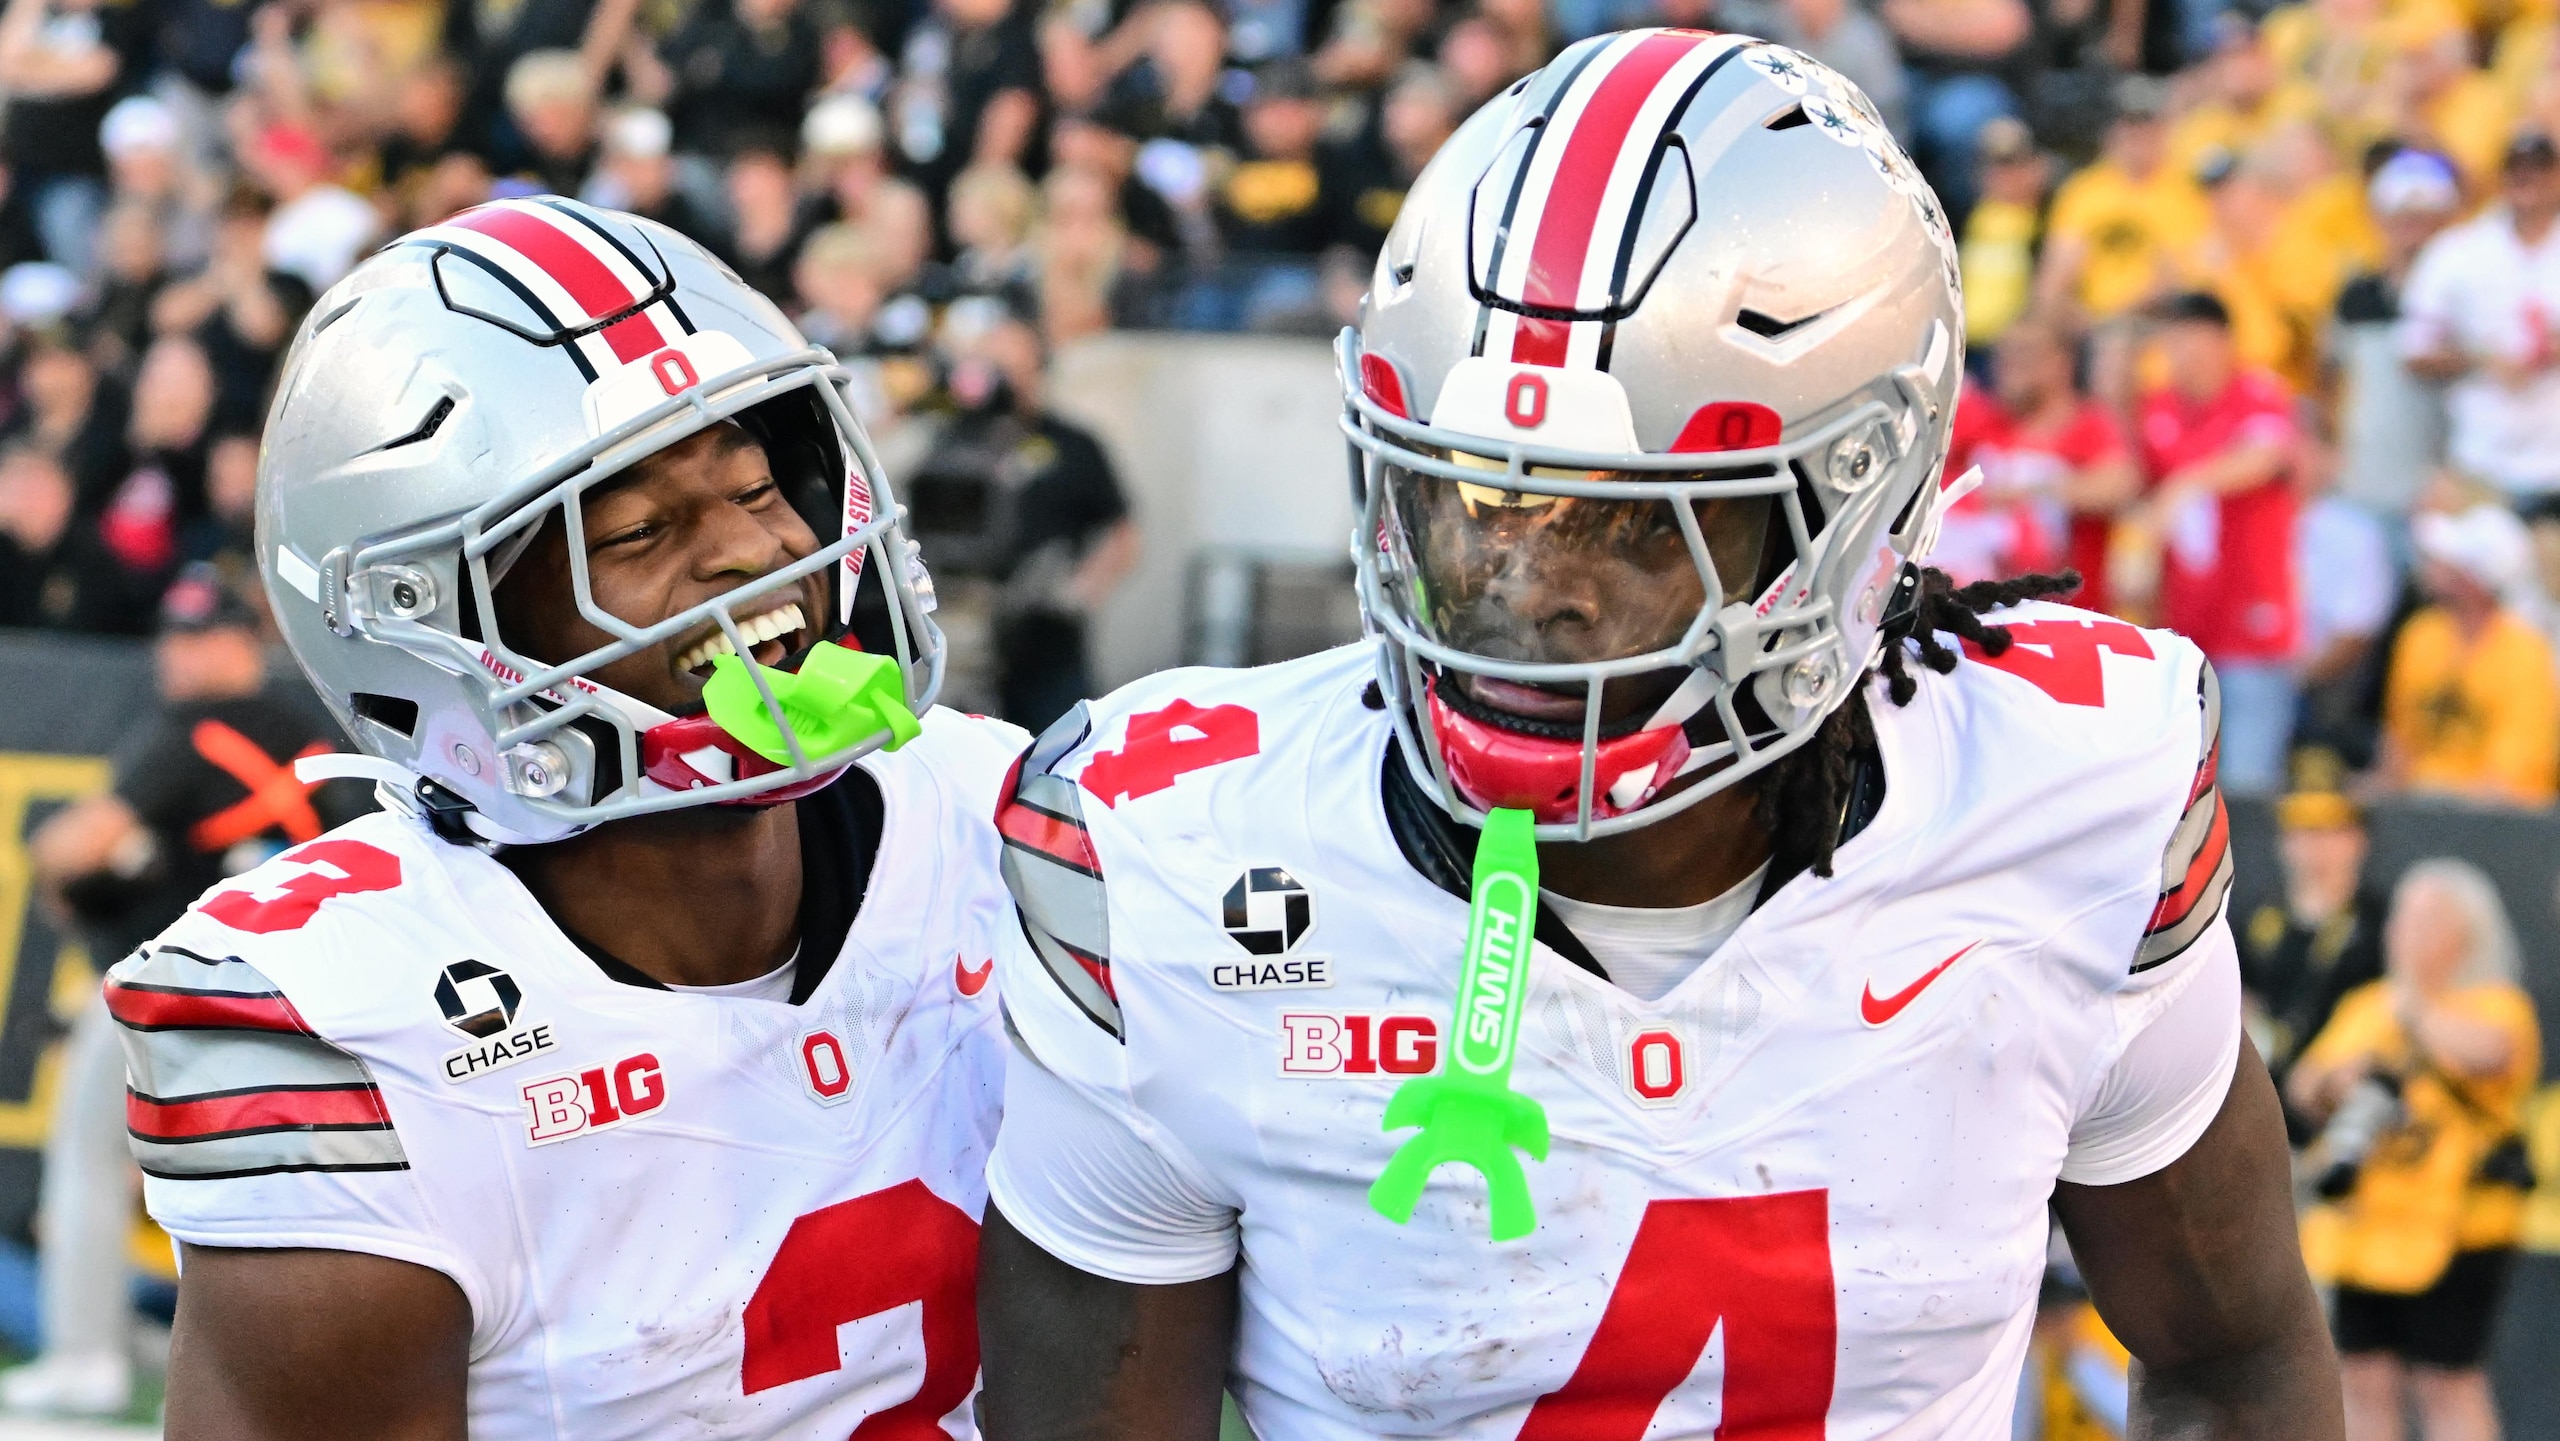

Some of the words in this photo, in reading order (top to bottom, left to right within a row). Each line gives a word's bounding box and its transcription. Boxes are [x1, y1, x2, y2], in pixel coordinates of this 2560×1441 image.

[649, 348, 700, 398] O
[1504, 371, 1550, 430] O
[848, 470, 871, 524] STATE
[1957, 619, 2156, 709] 4
[1079, 697, 1260, 810] 4
[197, 839, 402, 934] 3
[1213, 961, 1327, 986] CHASE
[446, 1025, 554, 1078] CHASE
[802, 1031, 851, 1098] O
[1631, 1031, 1683, 1099] O
[1515, 1188, 1837, 1441] 4
